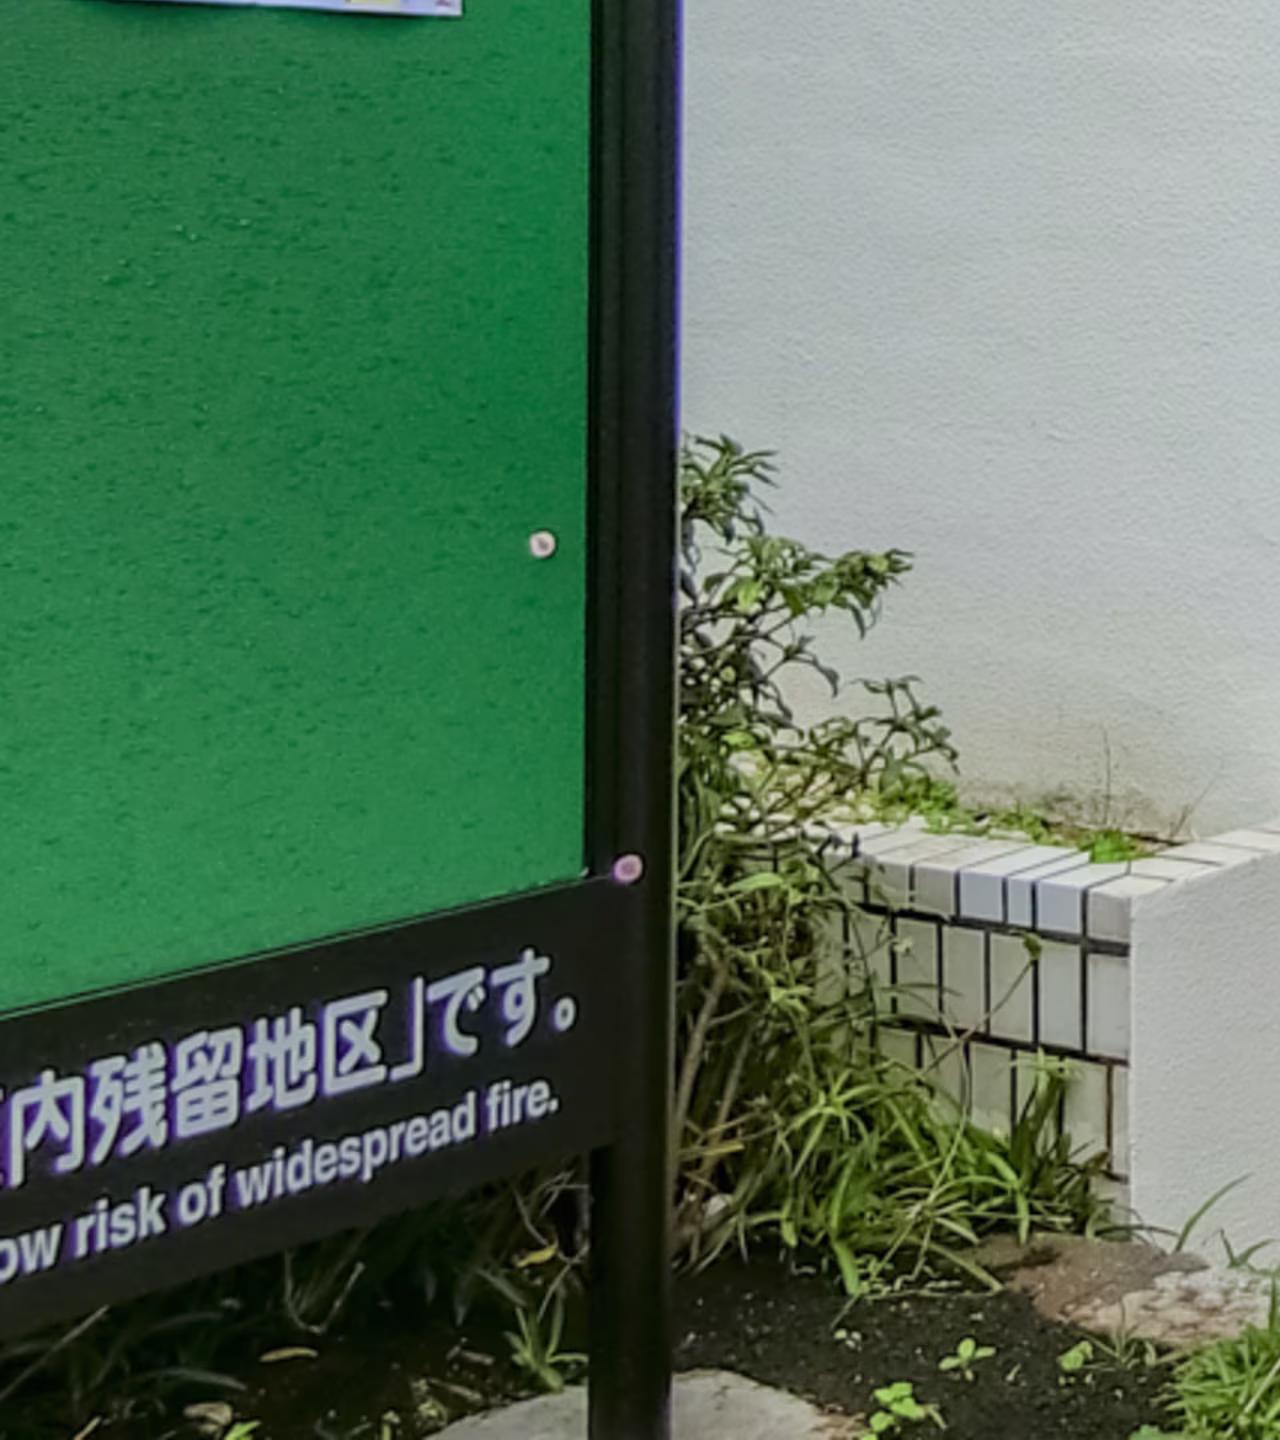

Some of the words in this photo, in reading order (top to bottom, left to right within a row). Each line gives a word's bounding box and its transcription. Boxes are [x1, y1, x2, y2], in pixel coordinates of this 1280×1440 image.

[0, 949, 576, 1187] 内残留地区」です。
[74, 1187, 166, 1258] risk
[179, 1165, 226, 1220] of
[237, 1091, 477, 1209] widespread
[486, 1077, 559, 1134] fire.
